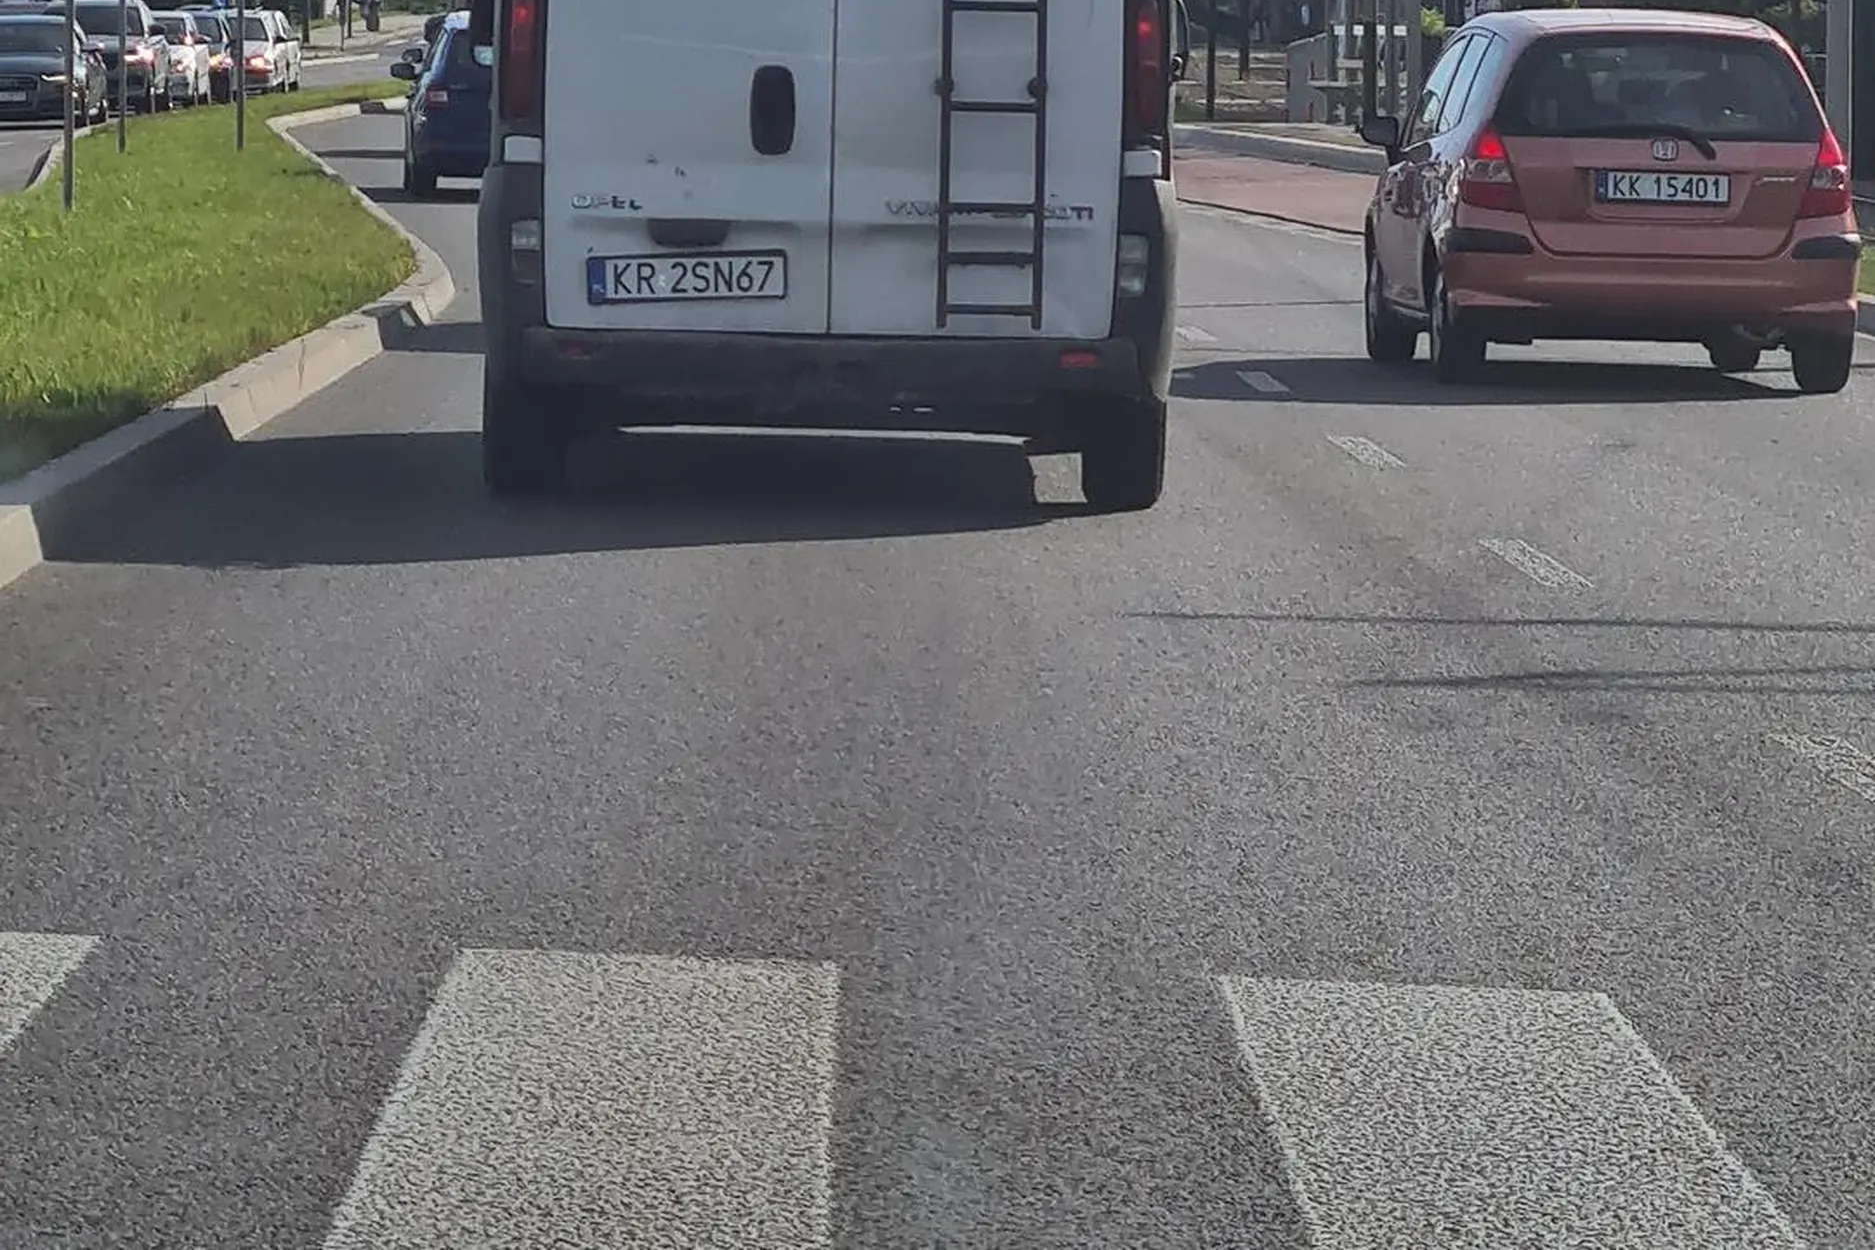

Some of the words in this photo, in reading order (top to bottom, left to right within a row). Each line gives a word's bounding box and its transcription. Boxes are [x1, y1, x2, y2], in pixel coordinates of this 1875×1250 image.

[1612, 173, 1641, 197] KK
[1653, 175, 1721, 199] 15401
[571, 194, 643, 211] OPEL
[612, 261, 657, 296] KR
[670, 259, 776, 294] 2SN67
